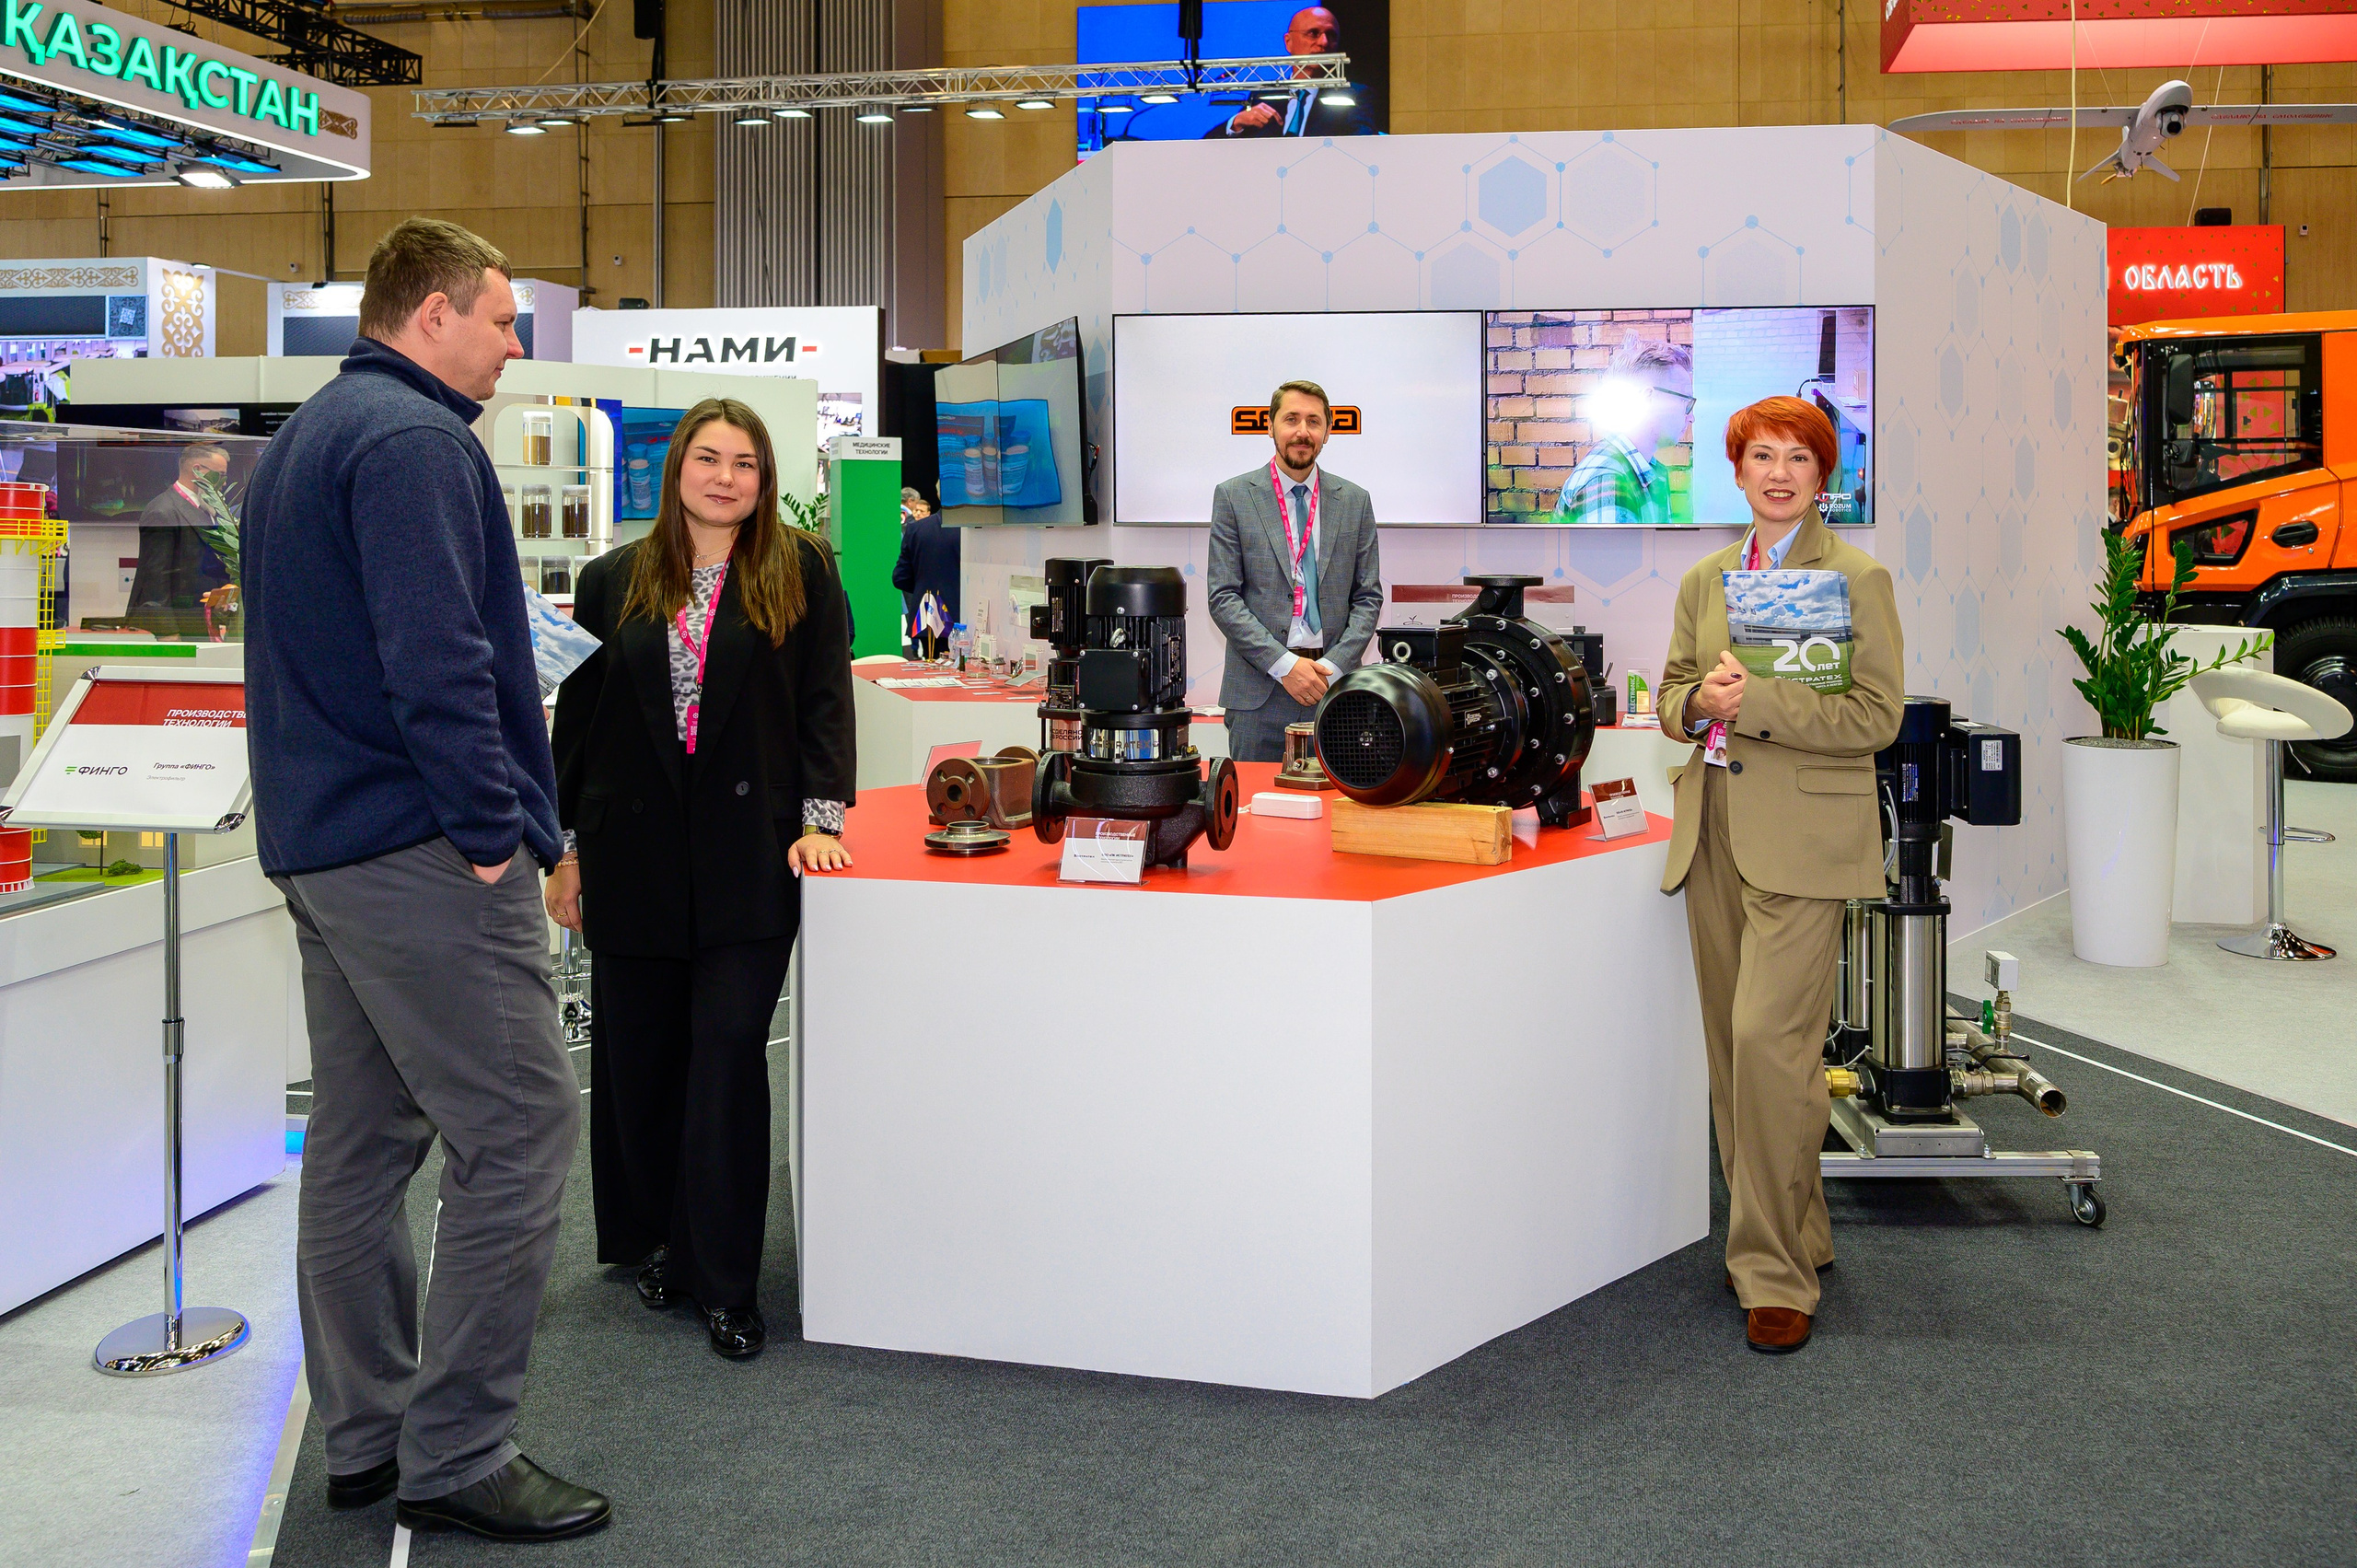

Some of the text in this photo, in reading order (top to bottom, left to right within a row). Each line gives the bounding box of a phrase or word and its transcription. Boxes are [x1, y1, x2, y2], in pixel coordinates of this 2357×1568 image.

[3, 0, 319, 136] ҚАЗАҚСТАН
[2125, 263, 2243, 290] ОБЛАСТЬ
[649, 337, 795, 363] НАМИ
[1772, 636, 1840, 672] 20
[1817, 662, 1840, 671] лет
[162, 719, 232, 727] ТЕХНОЛОГИИ
[78, 766, 128, 775] ФИНГО
